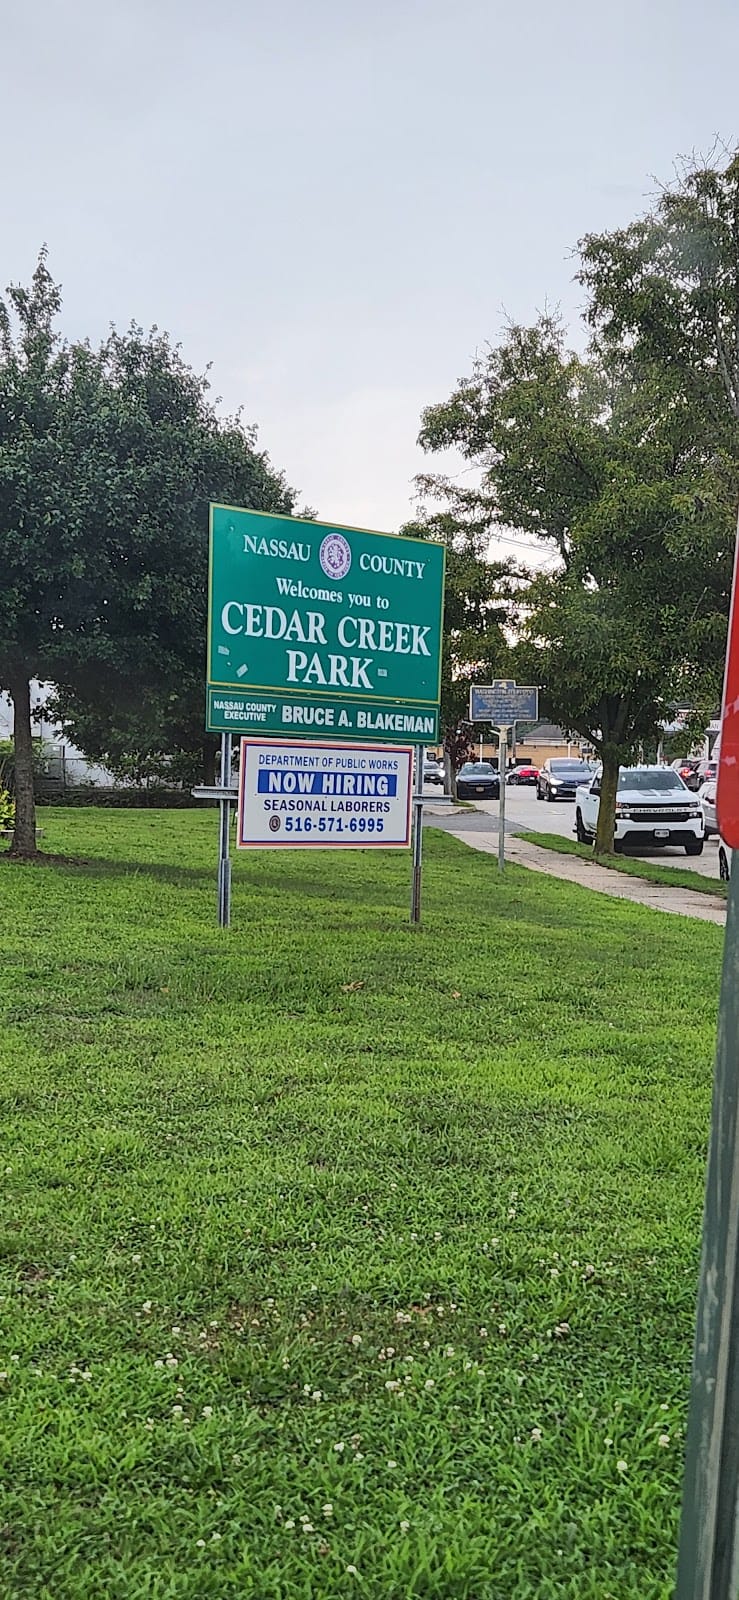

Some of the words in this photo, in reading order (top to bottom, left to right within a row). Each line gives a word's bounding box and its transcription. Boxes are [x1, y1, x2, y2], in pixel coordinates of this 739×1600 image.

[243, 534, 311, 562] NASSAU
[360, 553, 426, 579] COUNTY
[276, 578, 343, 603] Welcomes
[348, 594, 371, 608] you
[376, 594, 389, 610] to
[221, 600, 328, 645] CEDAR
[338, 616, 432, 656] CREEK
[286, 650, 374, 689] PARK
[214, 700, 244, 711] NASSAU
[246, 702, 276, 713] COUNTY
[224, 710, 266, 722] EXECUTIVE
[282, 706, 334, 726] BRUCE
[338, 710, 352, 727] A.
[357, 711, 434, 734] BLAKEMAN
[258, 754, 320, 767] DEPARTMENT
[322, 757, 333, 768] OF
[336, 758, 366, 769] PUBLIC
[368, 760, 398, 770] WORKS
[268, 772, 315, 793] NOW
[322, 774, 388, 795] HIRING
[264, 799, 327, 812] SEASONAL
[331, 801, 390, 812] LABORERS
[285, 816, 384, 832] 516-571-6995
